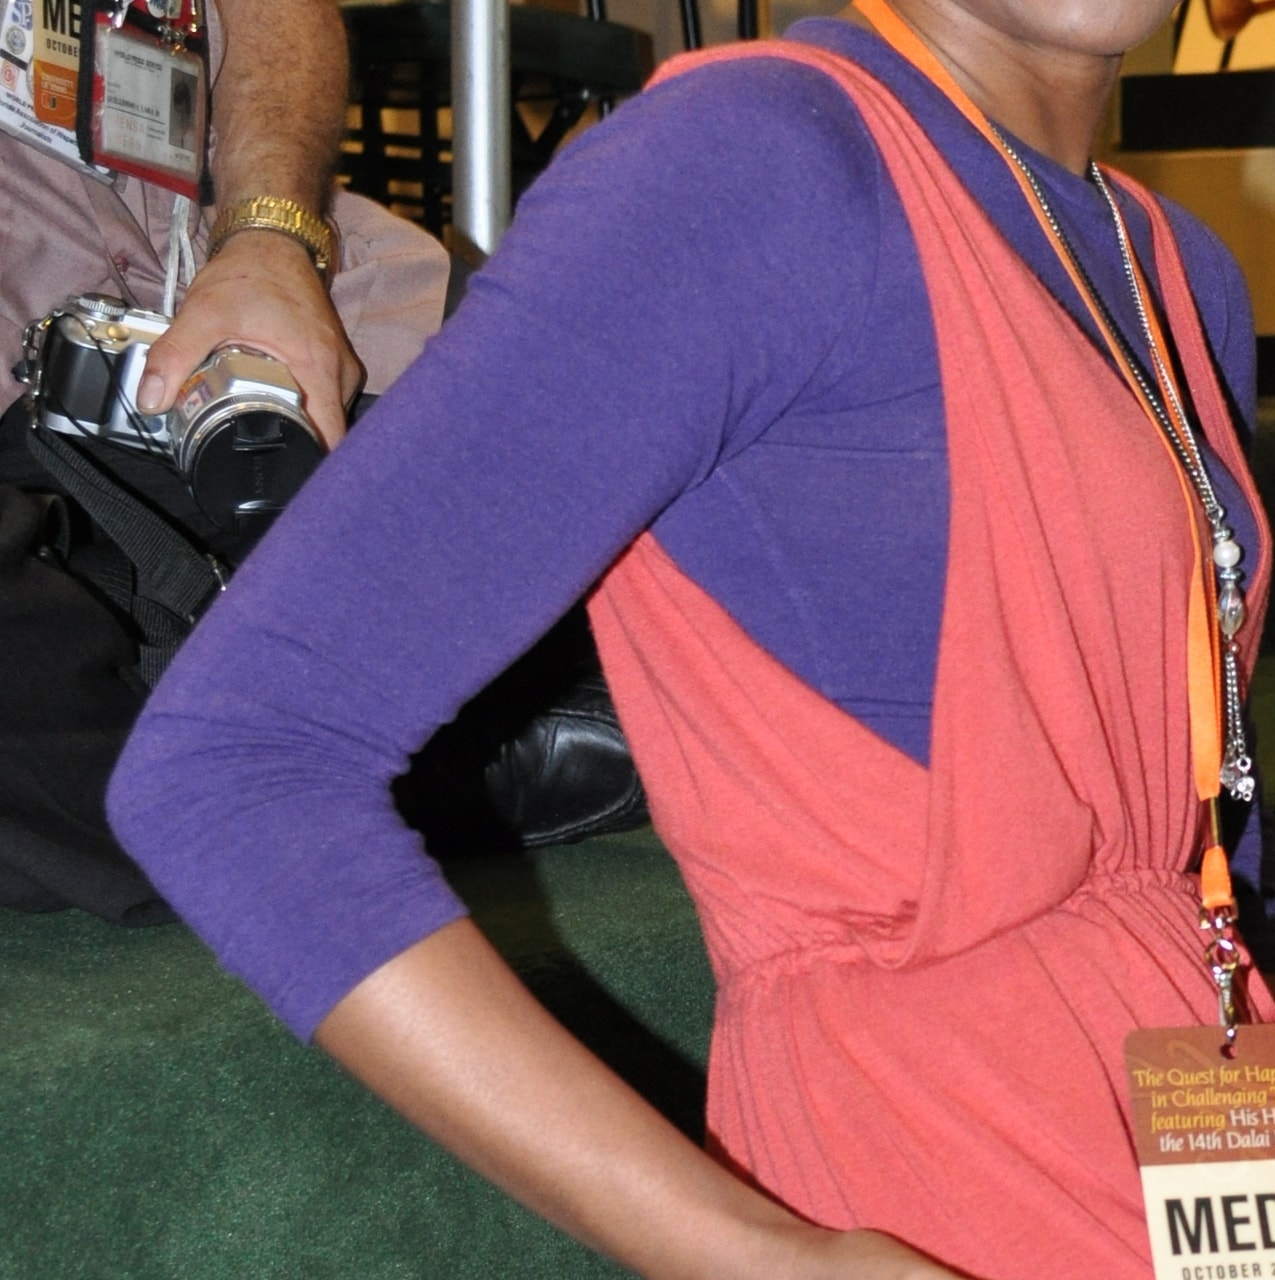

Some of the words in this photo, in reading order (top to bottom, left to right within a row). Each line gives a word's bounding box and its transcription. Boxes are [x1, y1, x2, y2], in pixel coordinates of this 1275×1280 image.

[46, 38, 79, 58] OCTOBE
[1132, 1067, 1165, 1087] The
[1167, 1068, 1215, 1086] Quest
[1219, 1064, 1241, 1087] for
[1151, 1091, 1168, 1108] in
[1171, 1087, 1268, 1108] Challenging
[1150, 1111, 1226, 1134] featuring
[1229, 1108, 1259, 1127] His
[1159, 1132, 1184, 1153] the
[1187, 1131, 1223, 1152] 14th
[1225, 1128, 1271, 1150] Dalai
